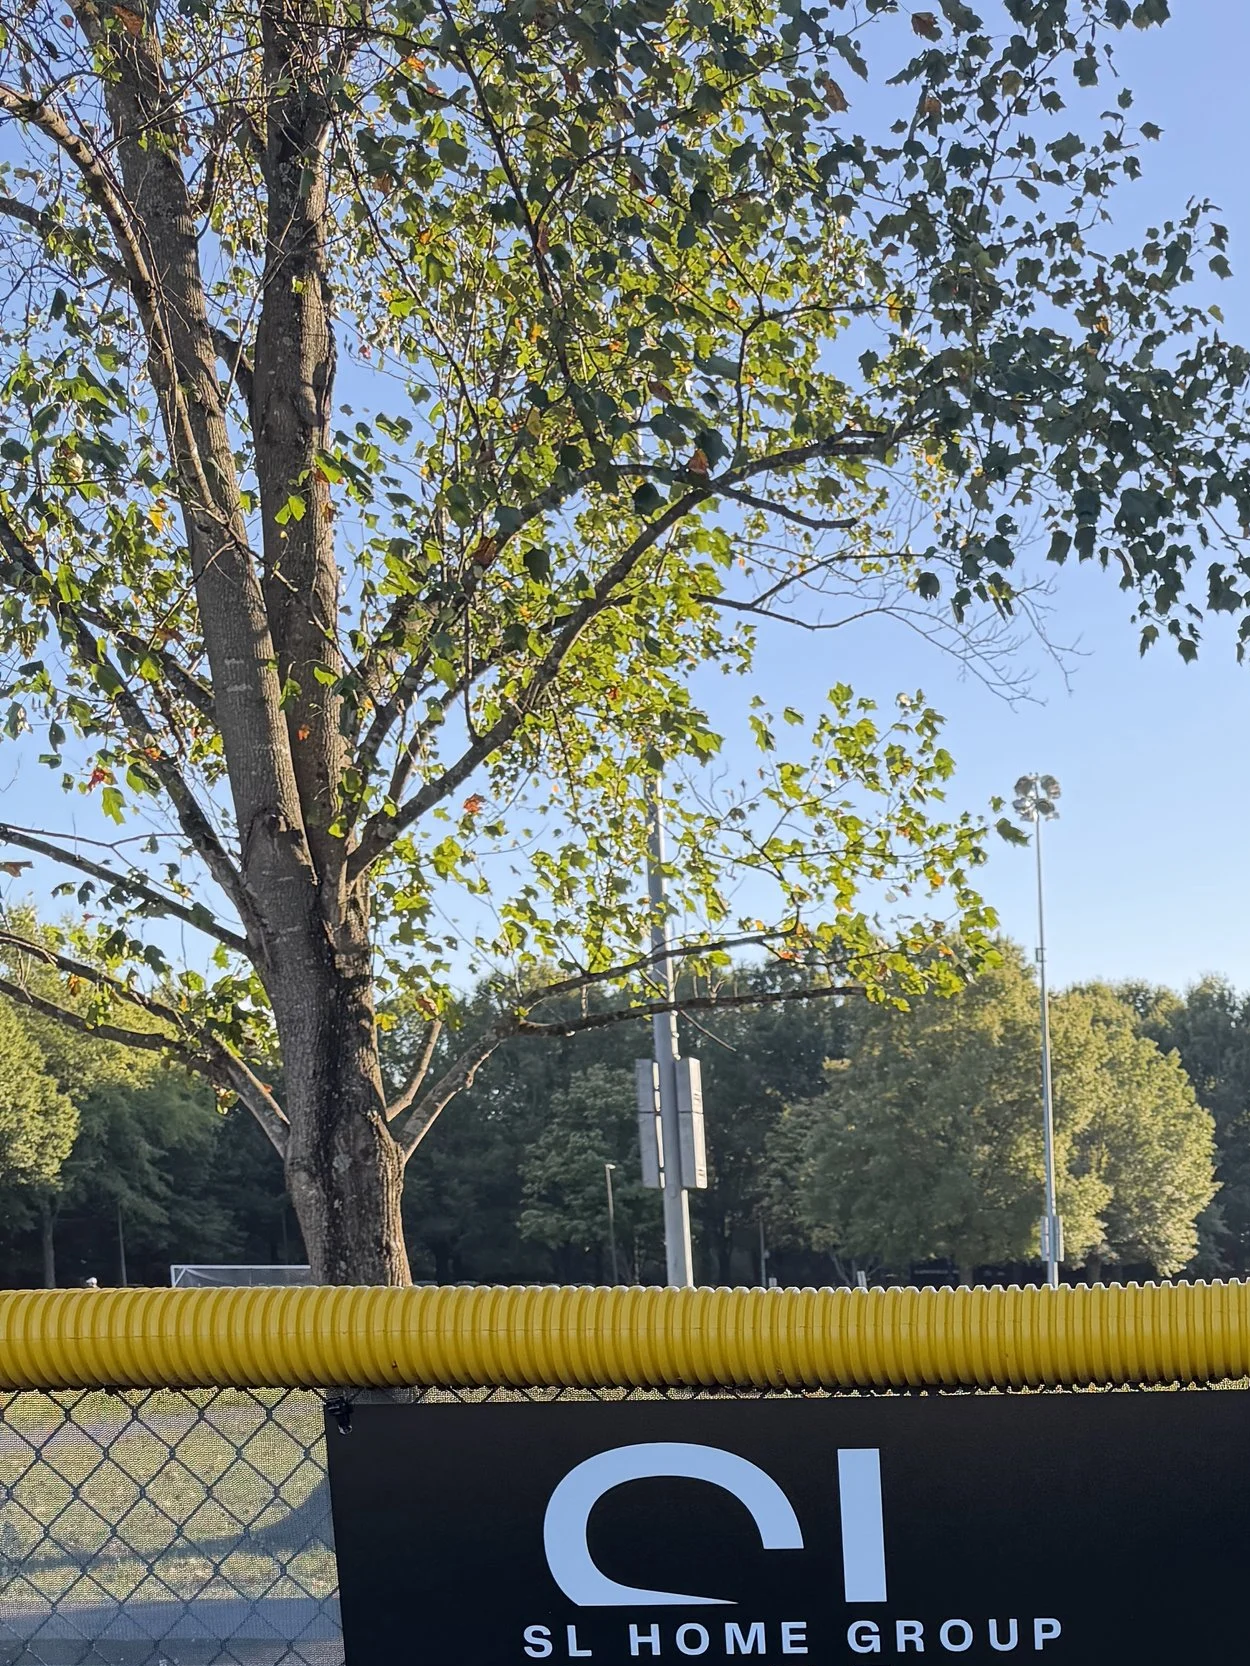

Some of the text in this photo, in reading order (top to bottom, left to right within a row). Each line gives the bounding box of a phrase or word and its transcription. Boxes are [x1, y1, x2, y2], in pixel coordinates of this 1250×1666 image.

[523, 1617, 1062, 1658] SL HOME GROUP
